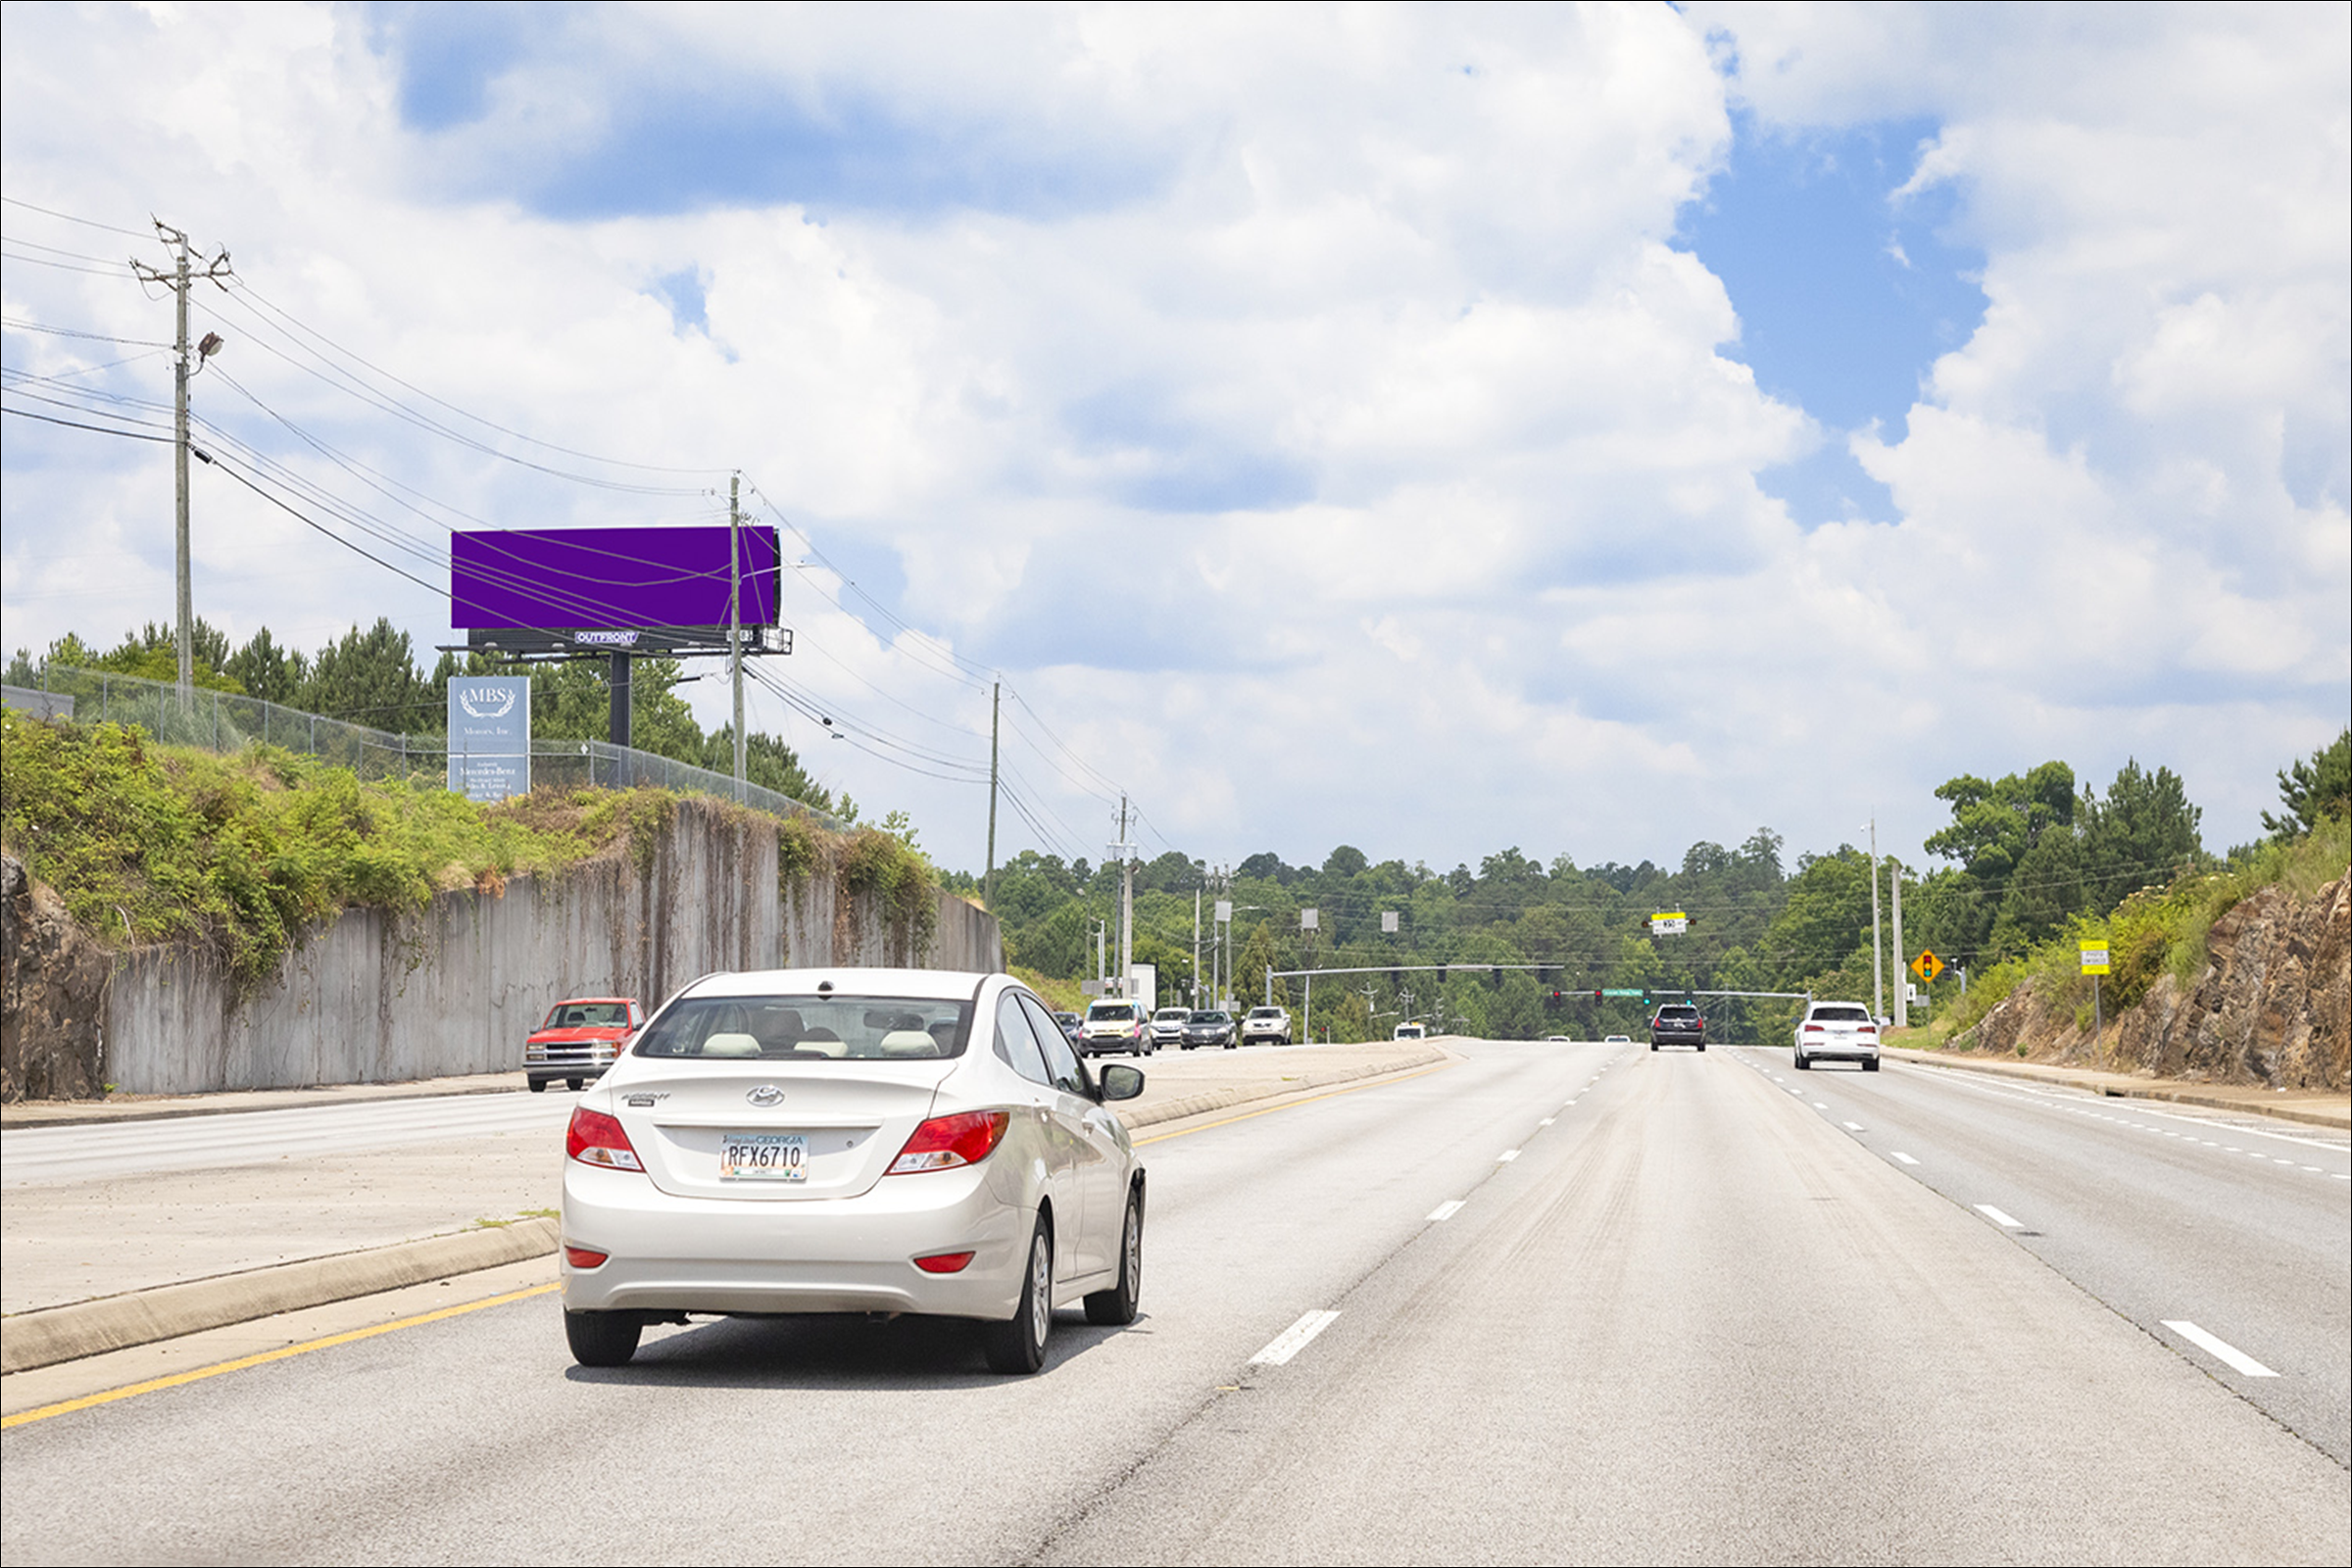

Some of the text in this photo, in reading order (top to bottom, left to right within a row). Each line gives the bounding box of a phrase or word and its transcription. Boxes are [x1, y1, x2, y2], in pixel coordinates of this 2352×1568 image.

[576, 631, 639, 643] OUTFRONT
[469, 687, 507, 703] MBS
[755, 1135, 804, 1146] GEORGIA
[728, 1146, 801, 1167] RFX6710
